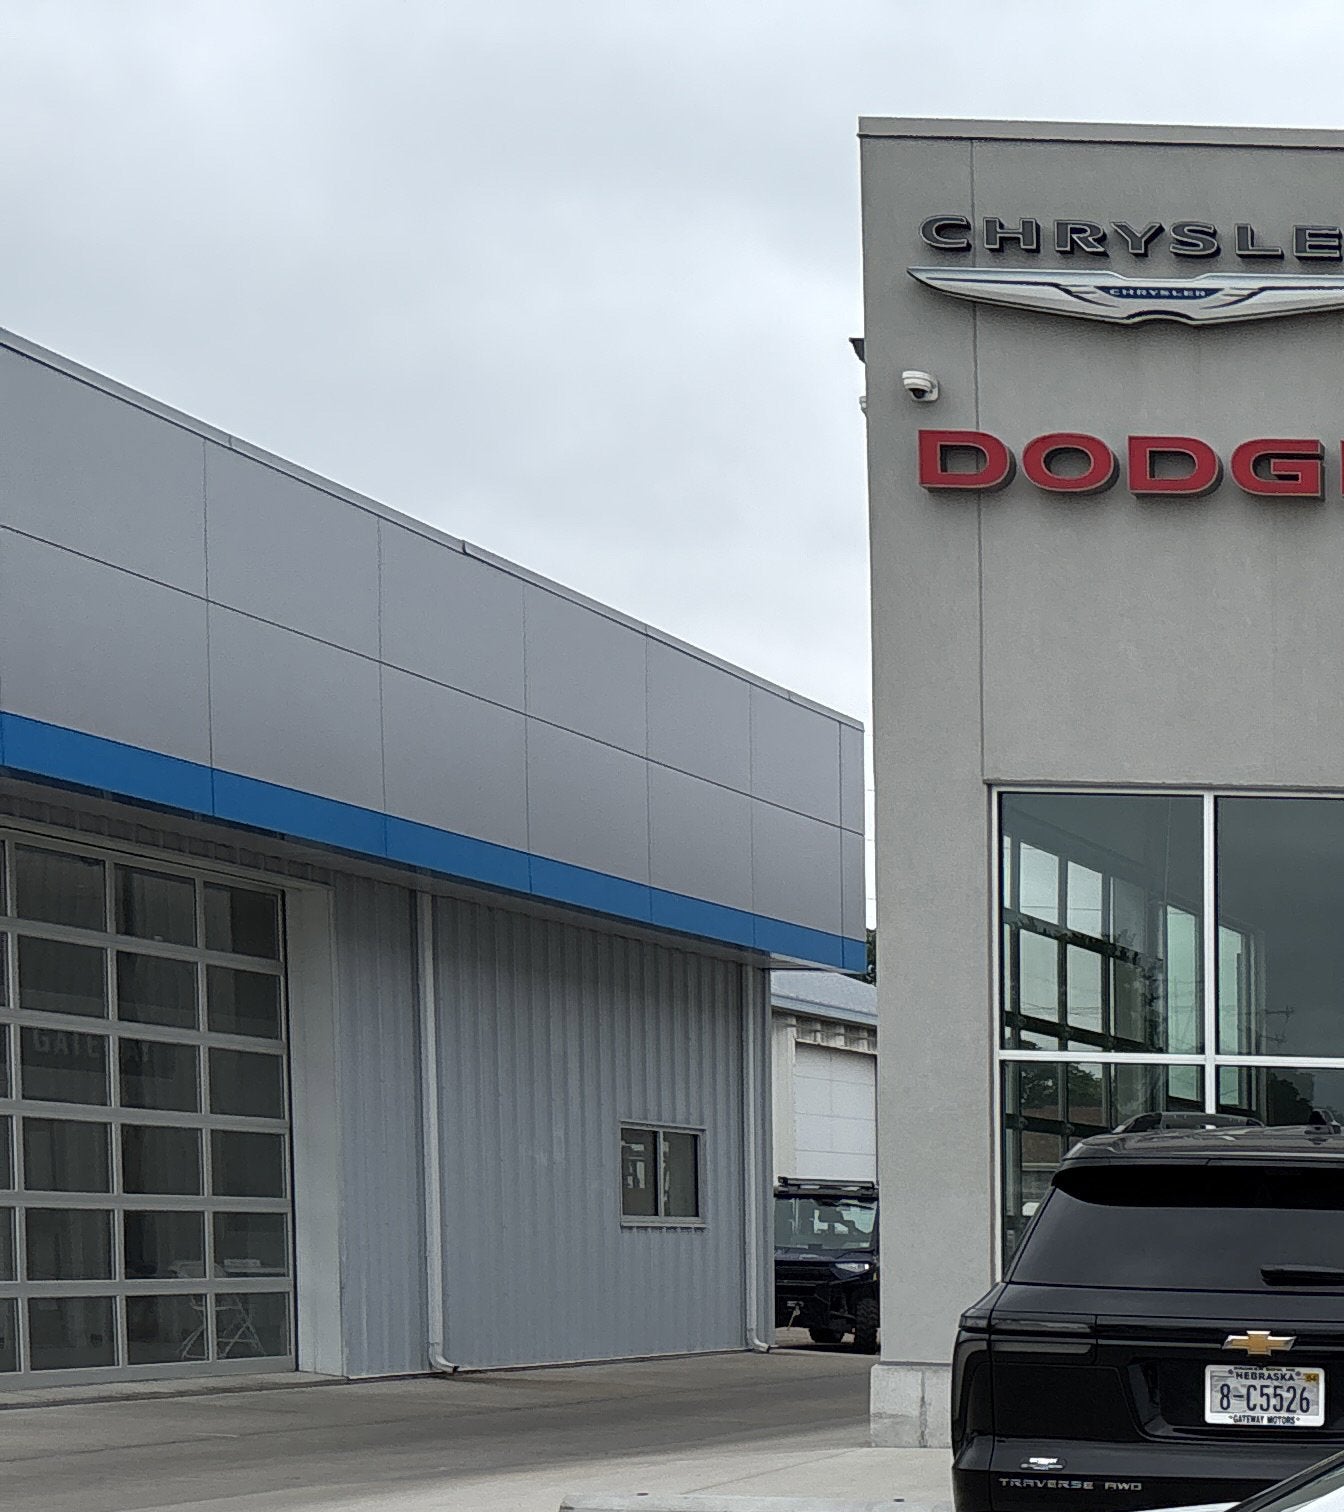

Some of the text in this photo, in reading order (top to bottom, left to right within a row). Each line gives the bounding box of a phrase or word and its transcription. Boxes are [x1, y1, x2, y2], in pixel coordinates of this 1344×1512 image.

[1109, 288, 1206, 297] CHRYSLER
[1235, 1371, 1295, 1381] NEBRASKA
[1219, 1383, 1311, 1414] 8-C5526
[1232, 1415, 1295, 1425] GATEWAY MOTORS
[998, 1477, 1142, 1491] TRAVERSE AWD
